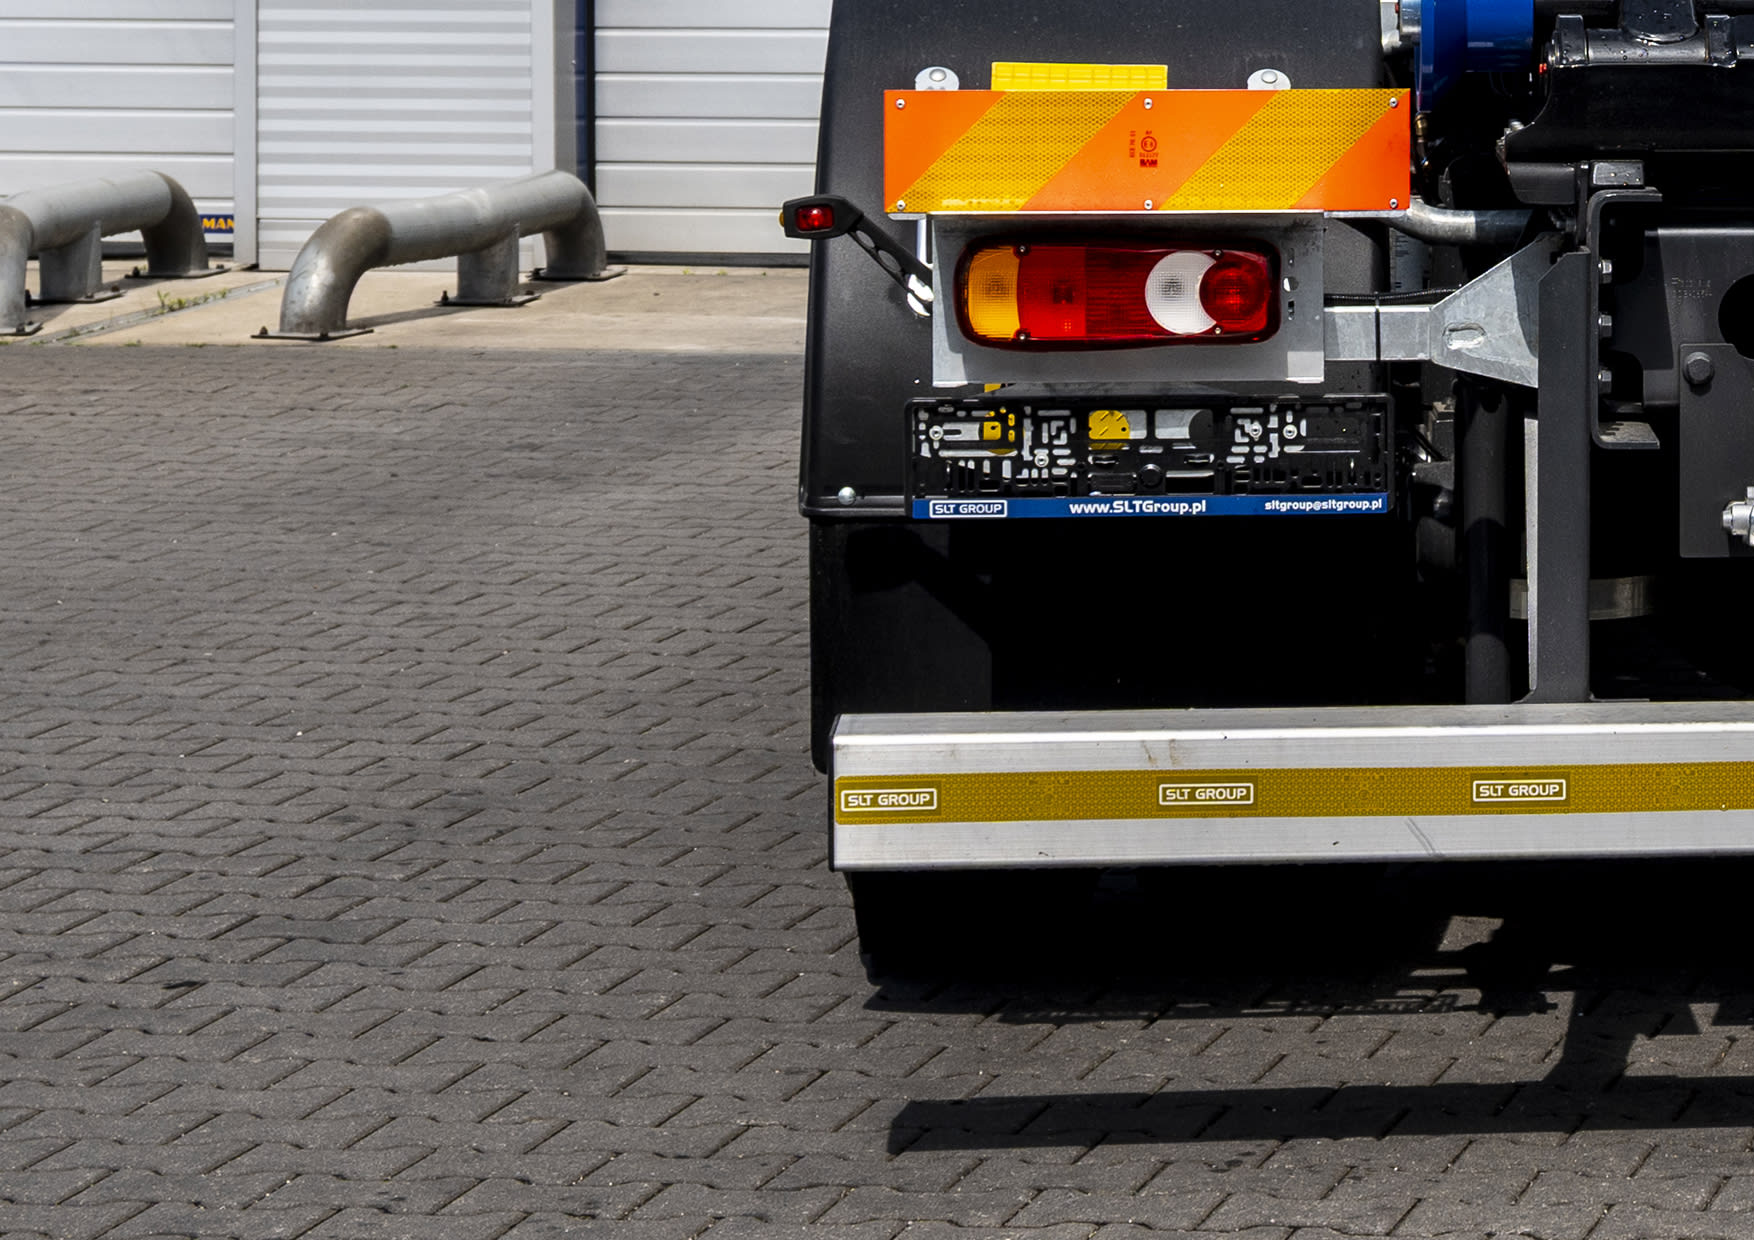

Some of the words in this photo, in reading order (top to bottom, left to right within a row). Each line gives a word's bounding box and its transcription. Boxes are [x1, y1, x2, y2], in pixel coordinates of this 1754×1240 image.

[934, 504, 956, 515] SLT
[959, 503, 1003, 515] GROUP
[1069, 499, 1207, 515] www.SLTGroup.pl
[1264, 498, 1383, 512] sltgroup@sltgroup.pl
[1166, 788, 1190, 800] SLT
[1195, 788, 1247, 800] GROUP
[1479, 785, 1504, 797] SLT
[1508, 784, 1560, 797] GROUP
[847, 794, 873, 807] SLT
[877, 793, 930, 806] GROUP
